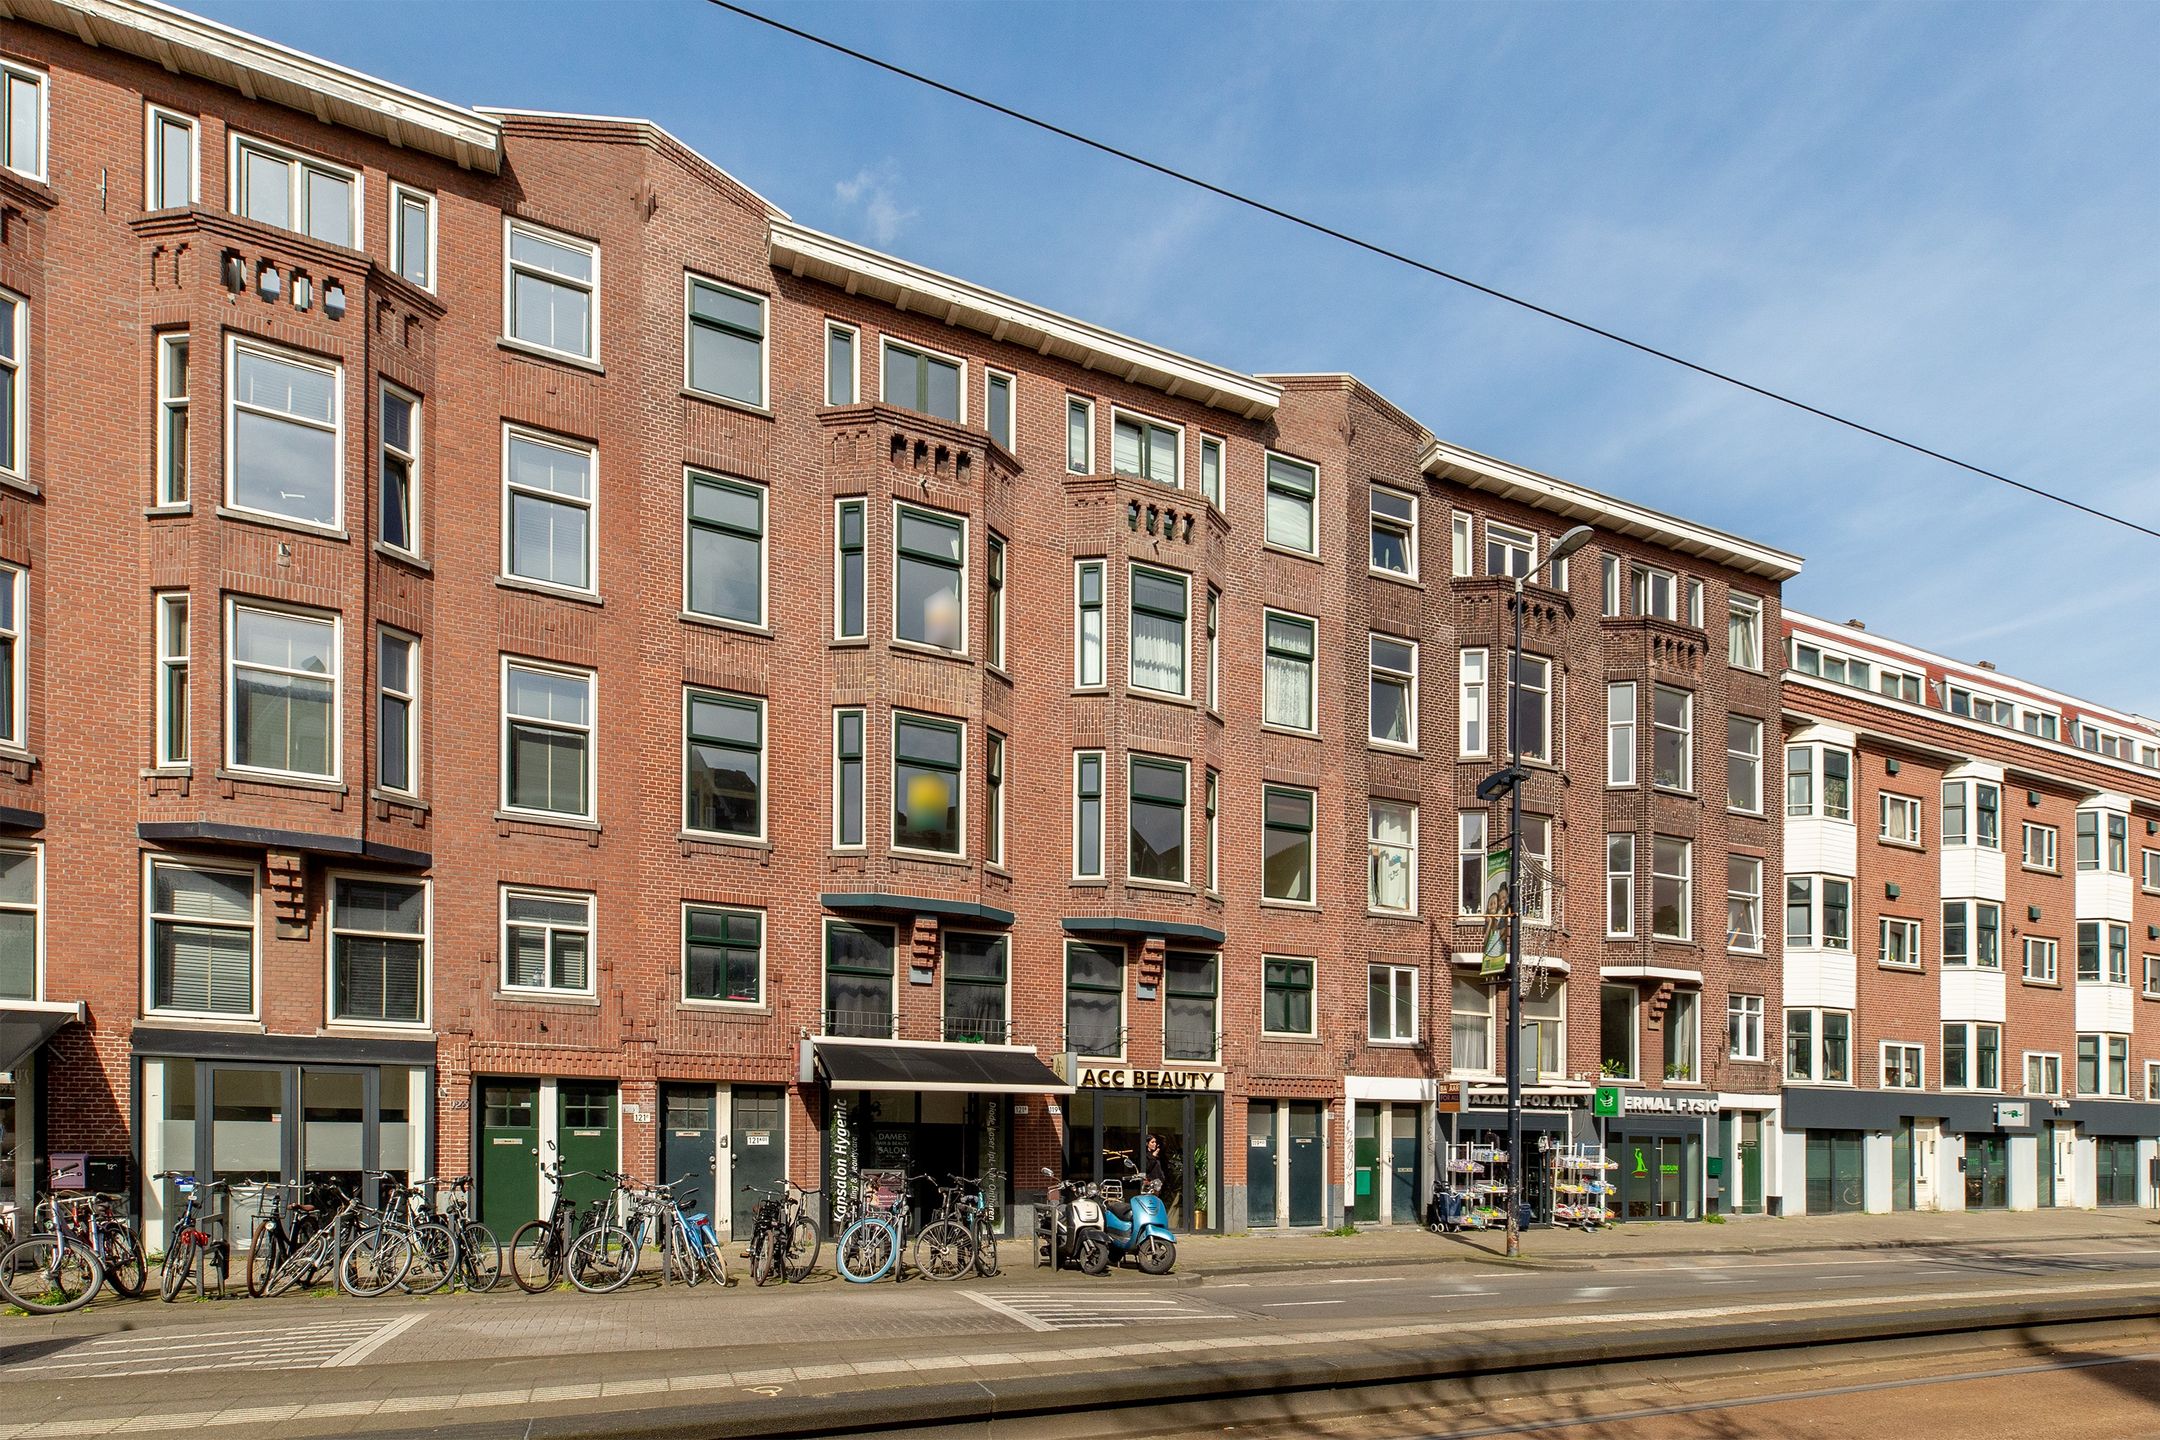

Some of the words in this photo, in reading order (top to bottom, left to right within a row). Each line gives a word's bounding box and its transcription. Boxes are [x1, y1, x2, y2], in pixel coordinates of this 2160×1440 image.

[1082, 1069, 1125, 1088] ACC
[1132, 1070, 1214, 1090] BEAUTY
[1468, 1095, 1509, 1105] AZAA
[1521, 1095, 1550, 1107] FOR
[1551, 1096, 1578, 1108] ALL
[1624, 1096, 1674, 1111] ERMAL
[1676, 1098, 1720, 1112] FYSIO
[833, 1099, 850, 1155] Hygenic
[878, 1133, 907, 1141] DAMES
[877, 1146, 907, 1154] SALON
